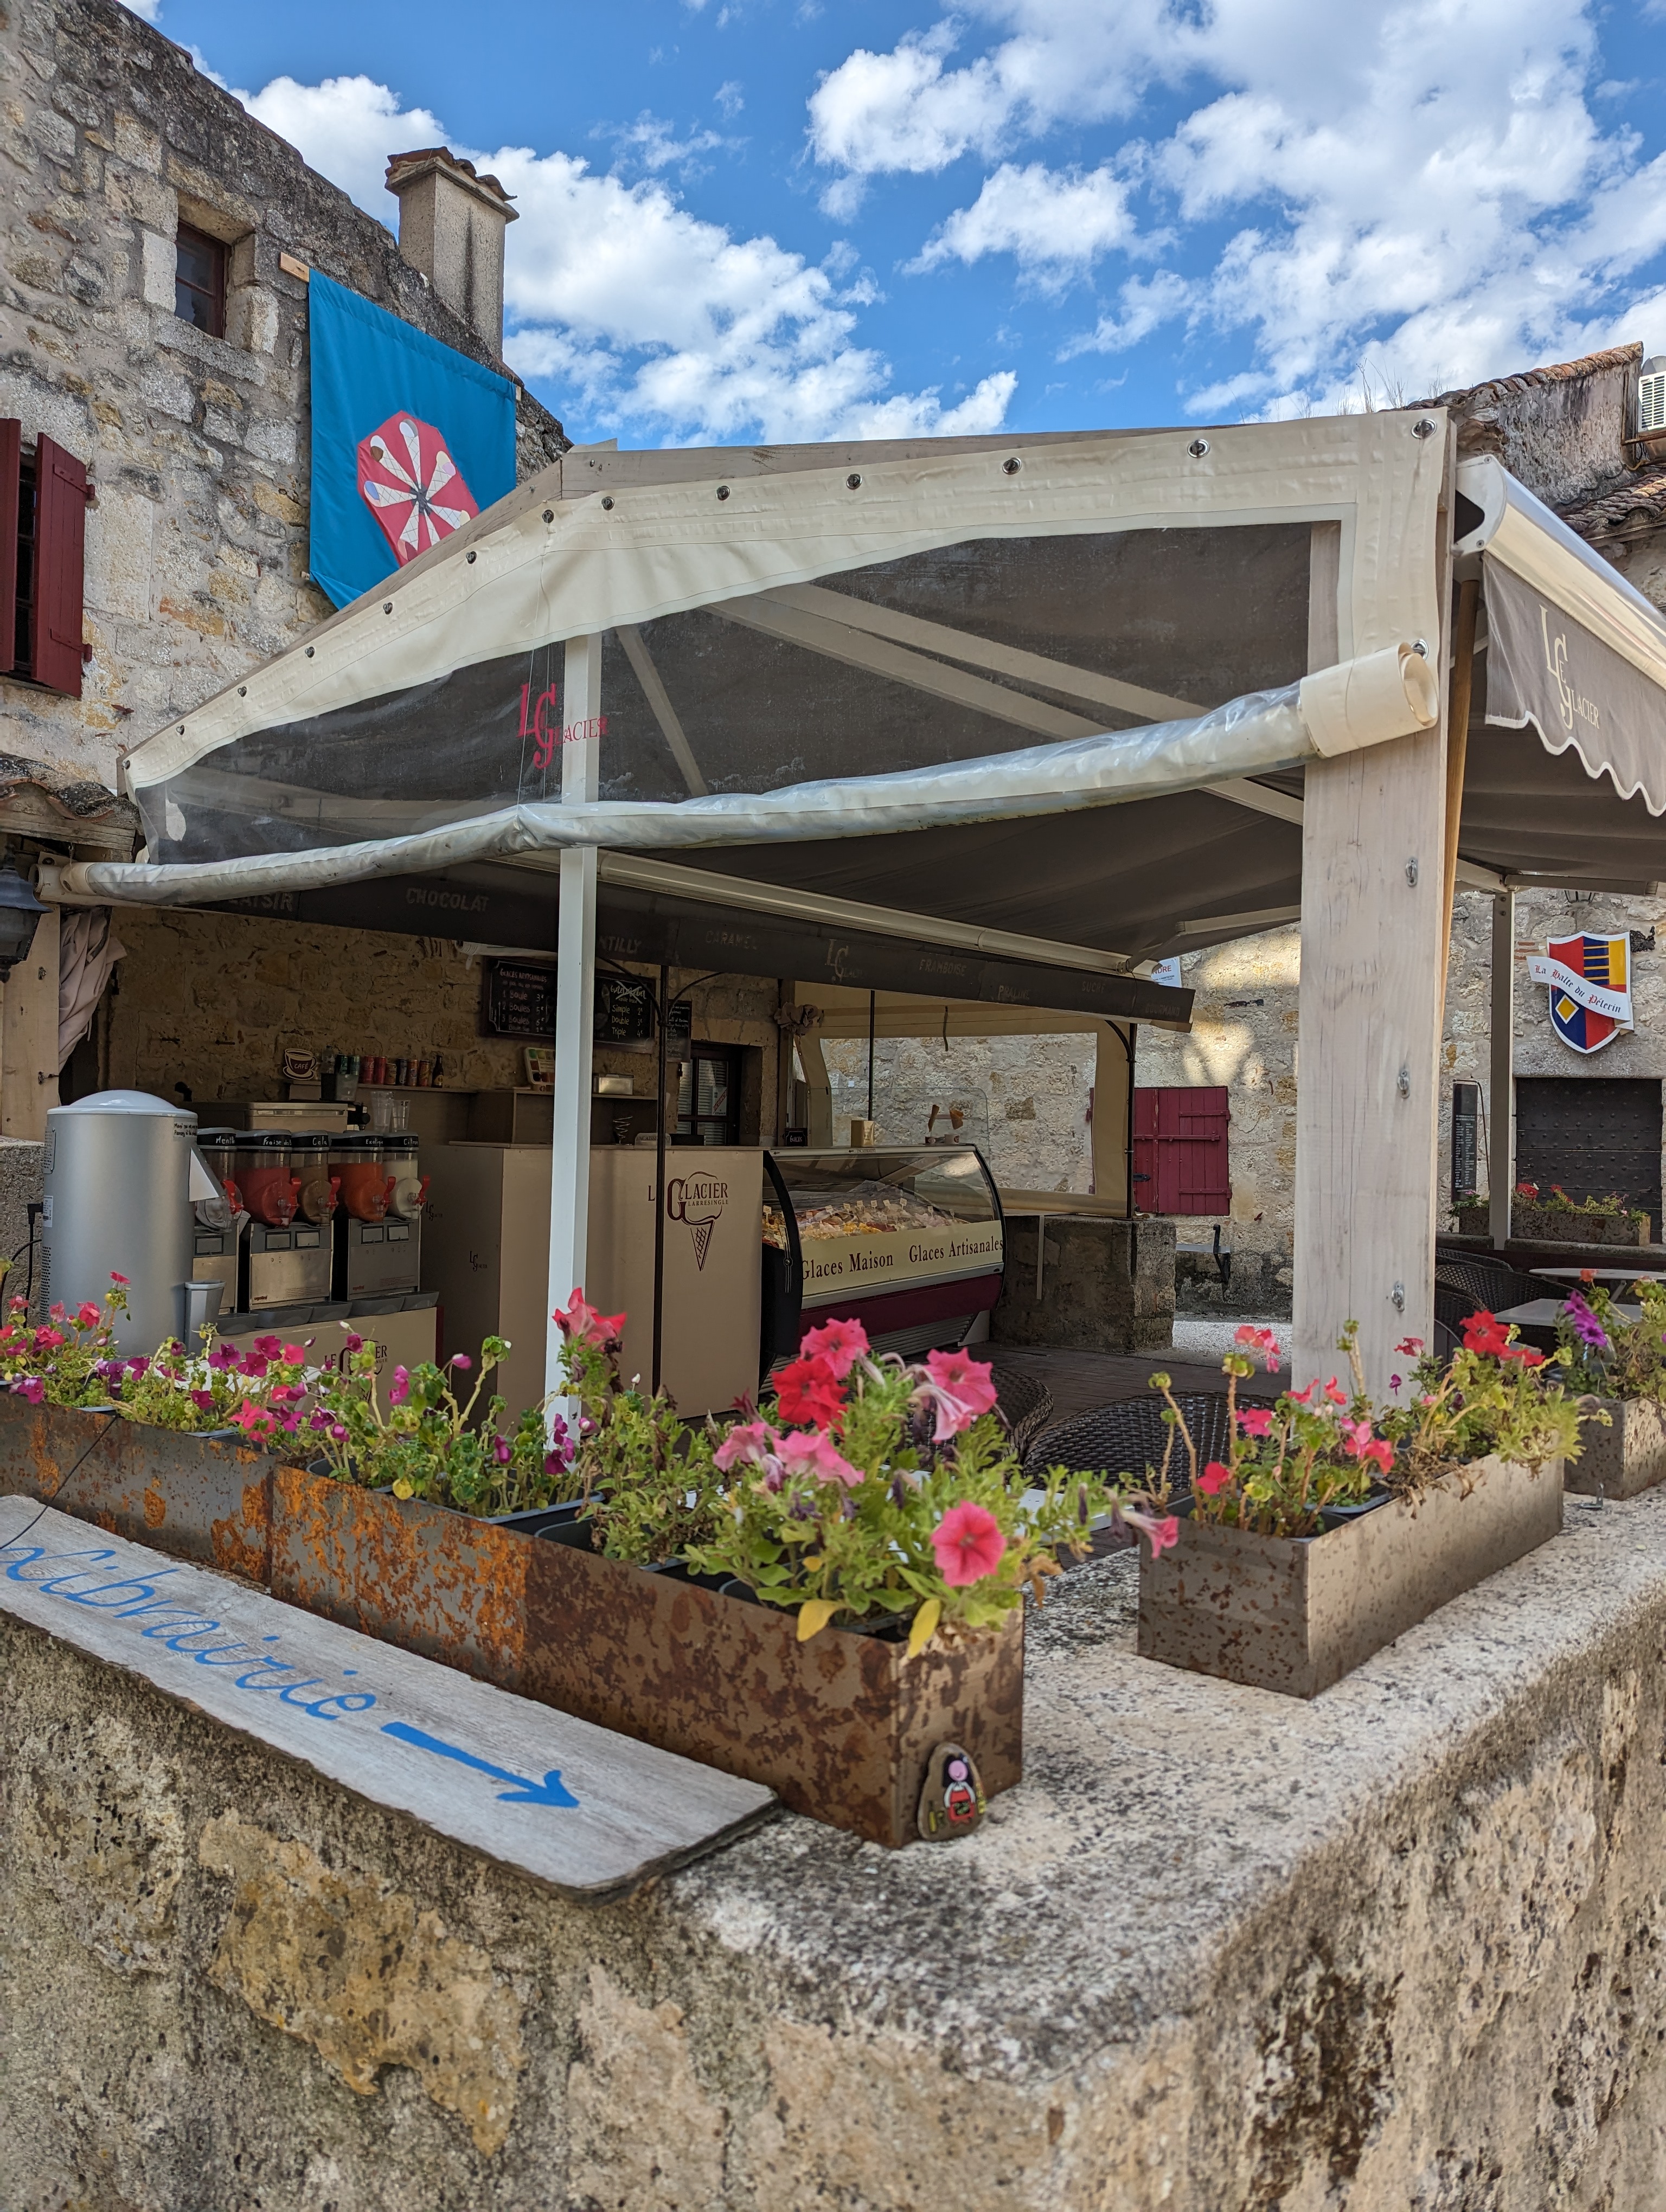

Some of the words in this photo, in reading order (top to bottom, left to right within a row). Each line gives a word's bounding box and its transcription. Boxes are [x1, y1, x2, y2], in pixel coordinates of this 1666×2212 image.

[406, 888, 490, 912] CHOCOLAT
[920, 958, 967, 977] FRAMBOISE
[510, 990, 528, 1000] Boule
[1535, 965, 1546, 974] La
[1550, 969, 1574, 988] Halte
[1574, 986, 1585, 997] du
[1587, 994, 1621, 1013] Pélerin
[509, 1002, 530, 1013] Boules
[612, 1005, 630, 1017] Simple
[509, 1014, 530, 1025] Boules
[612, 1015, 630, 1025] Double
[612, 1027, 626, 1039] Triple
[263, 1136, 282, 1145] Fraise
[313, 1135, 328, 1145] Cola
[366, 1137, 383, 1147] Exotiqu
[667, 1178, 728, 1221] GLACIER
[802, 1259, 843, 1280] Glaces
[849, 1250, 894, 1273] Maison
[909, 1244, 944, 1263] Glaces
[949, 1235, 1003, 1258] Artisanales
[0, 1547, 377, 1721] Librairie
